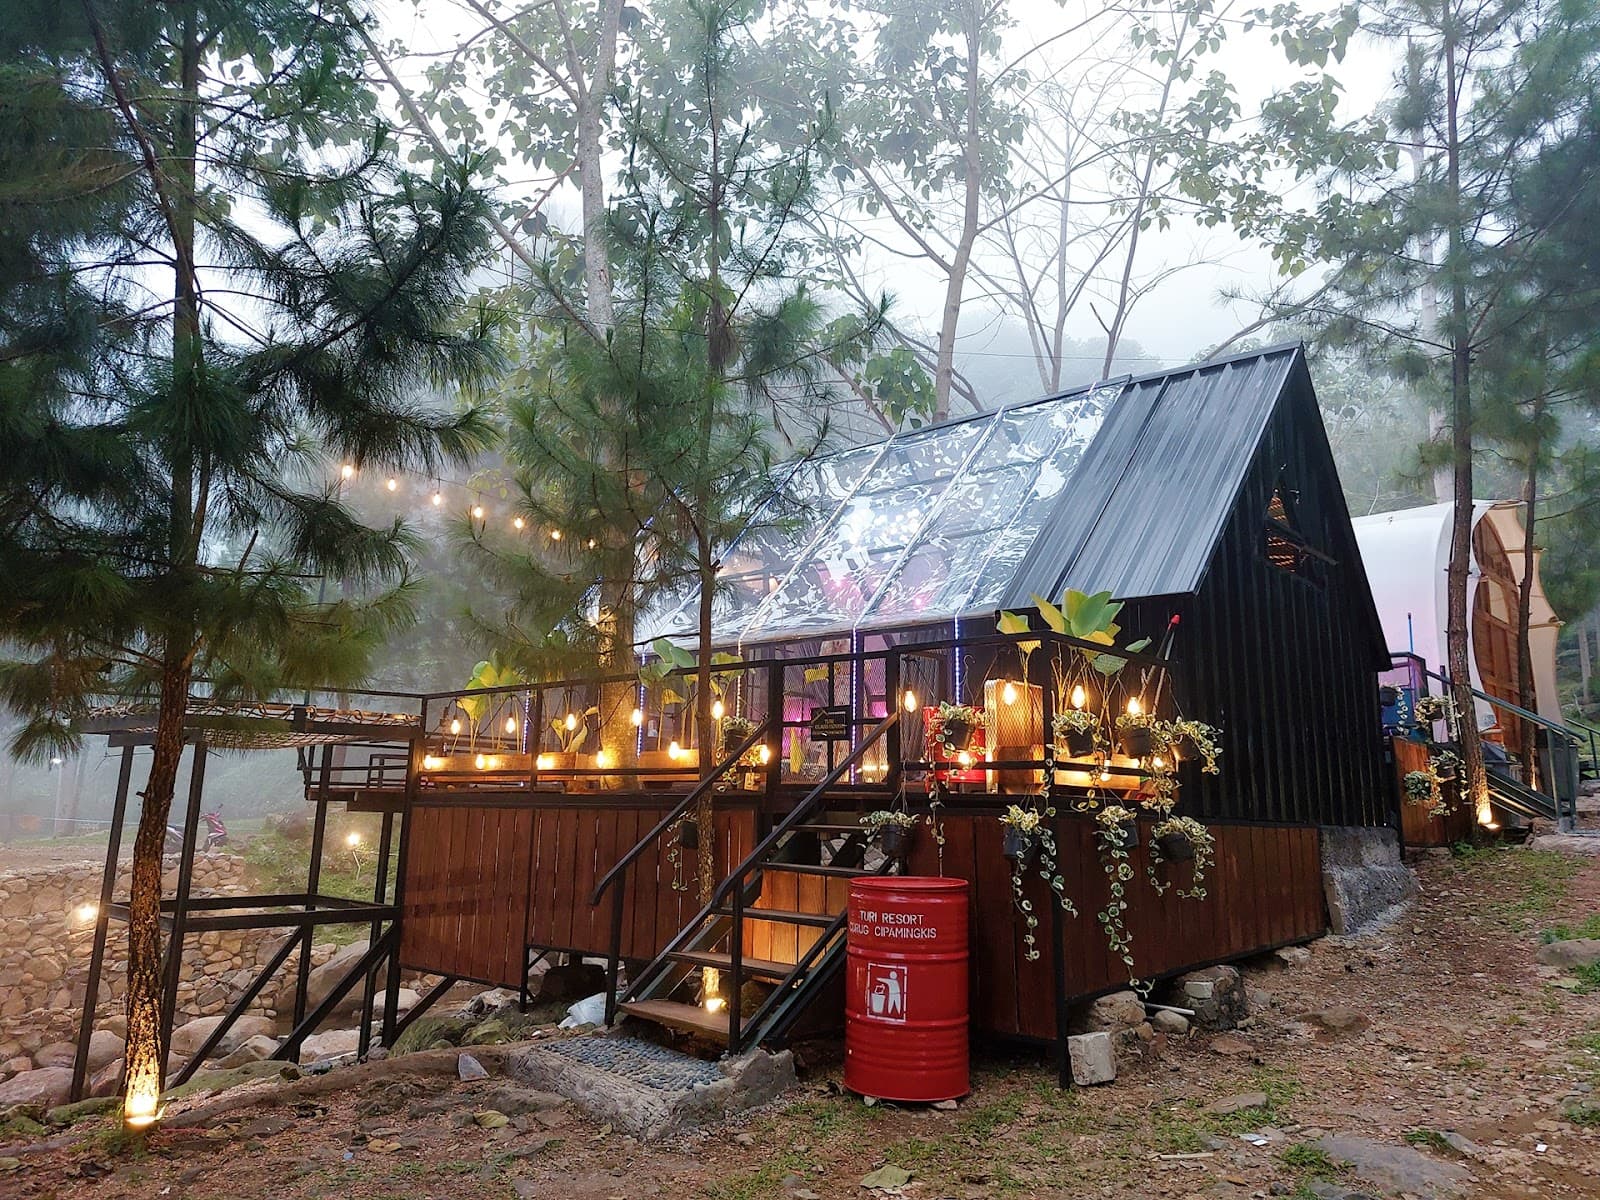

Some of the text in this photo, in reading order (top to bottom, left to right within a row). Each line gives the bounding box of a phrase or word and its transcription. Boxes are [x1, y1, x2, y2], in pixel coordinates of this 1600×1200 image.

[860, 910, 924, 925] TURI RESORT
[874, 926, 937, 938] CIPAMINGKIS
